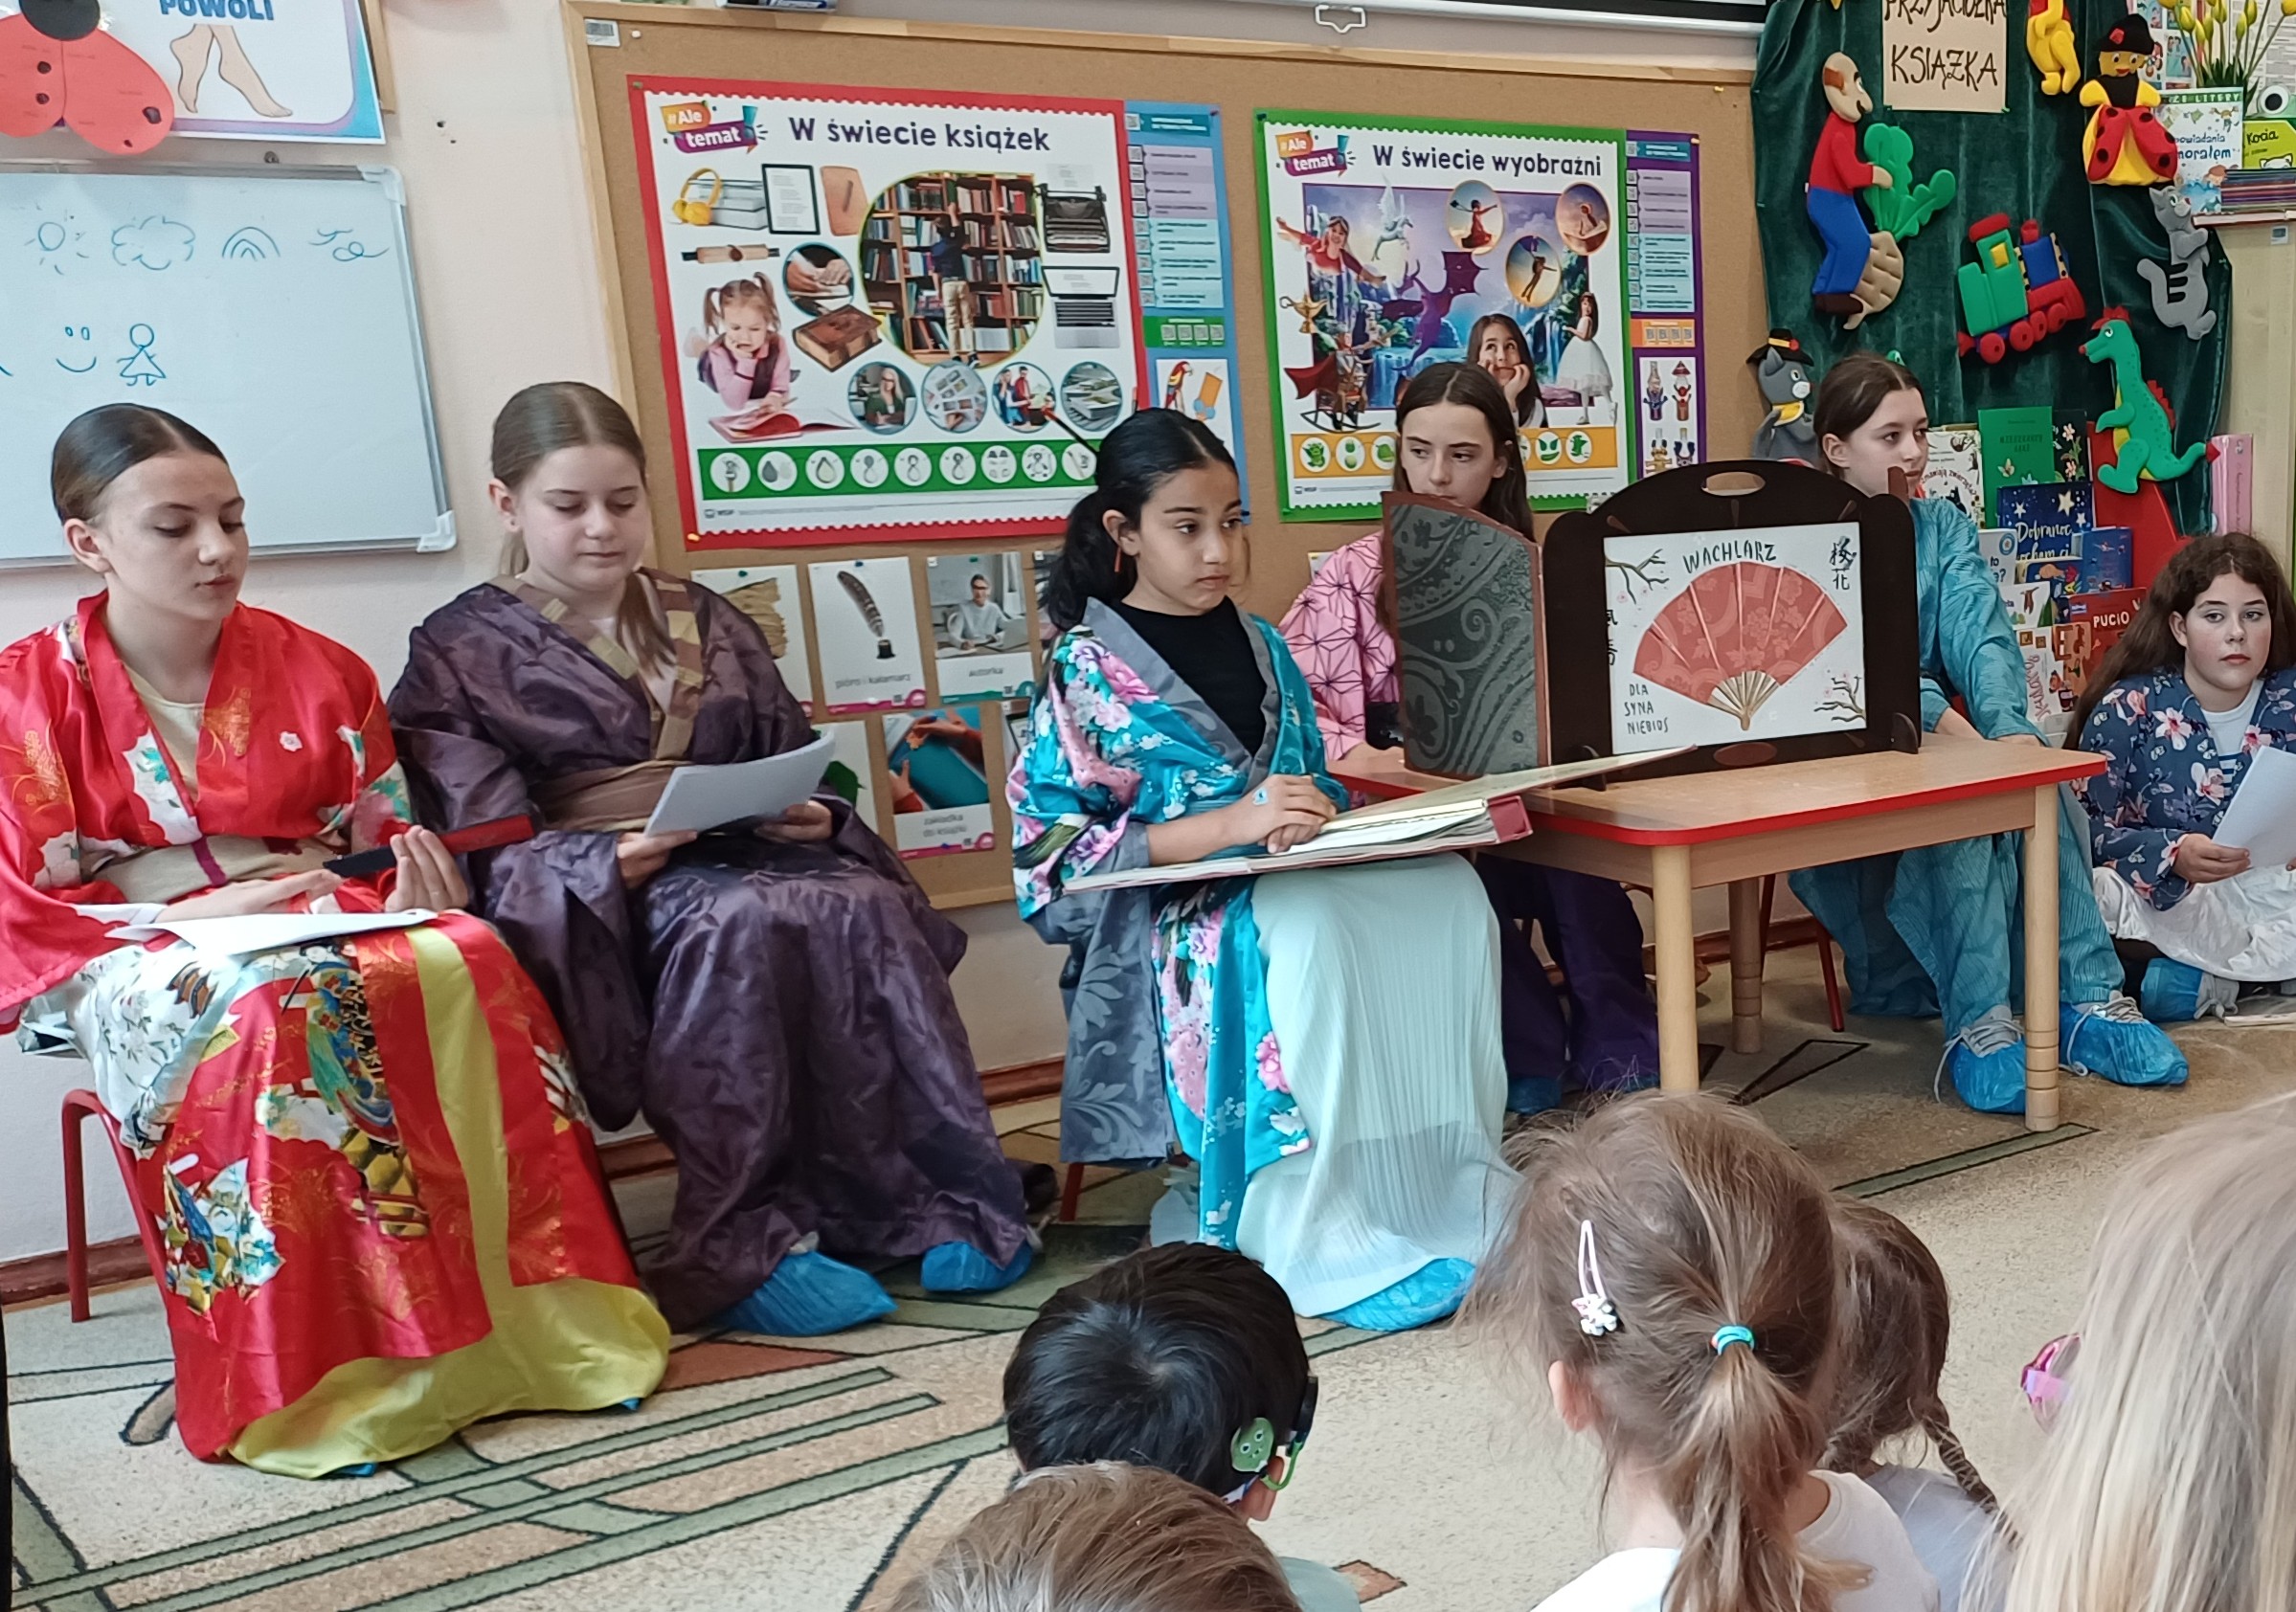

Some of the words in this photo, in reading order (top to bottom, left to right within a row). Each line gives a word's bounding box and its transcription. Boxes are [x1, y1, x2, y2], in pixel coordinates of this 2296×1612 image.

[160, 0, 274, 20] POWOLI
[1891, 44, 1998, 92] KSIĄŻKA
[789, 117, 815, 142] W
[827, 119, 936, 146] świecie
[945, 123, 1050, 154] książek
[1373, 145, 1394, 167] W
[1402, 146, 1485, 170] świecie
[1492, 152, 1602, 177] wyobraźni
[2015, 519, 2073, 543] Dobranoc
[1682, 539, 1777, 573] WACHLARZ
[2093, 611, 2130, 628] PUCIO
[1630, 683, 1649, 697] DLA
[1624, 701, 1654, 716] SYNA
[1627, 717, 1669, 734] NIEBIOS
